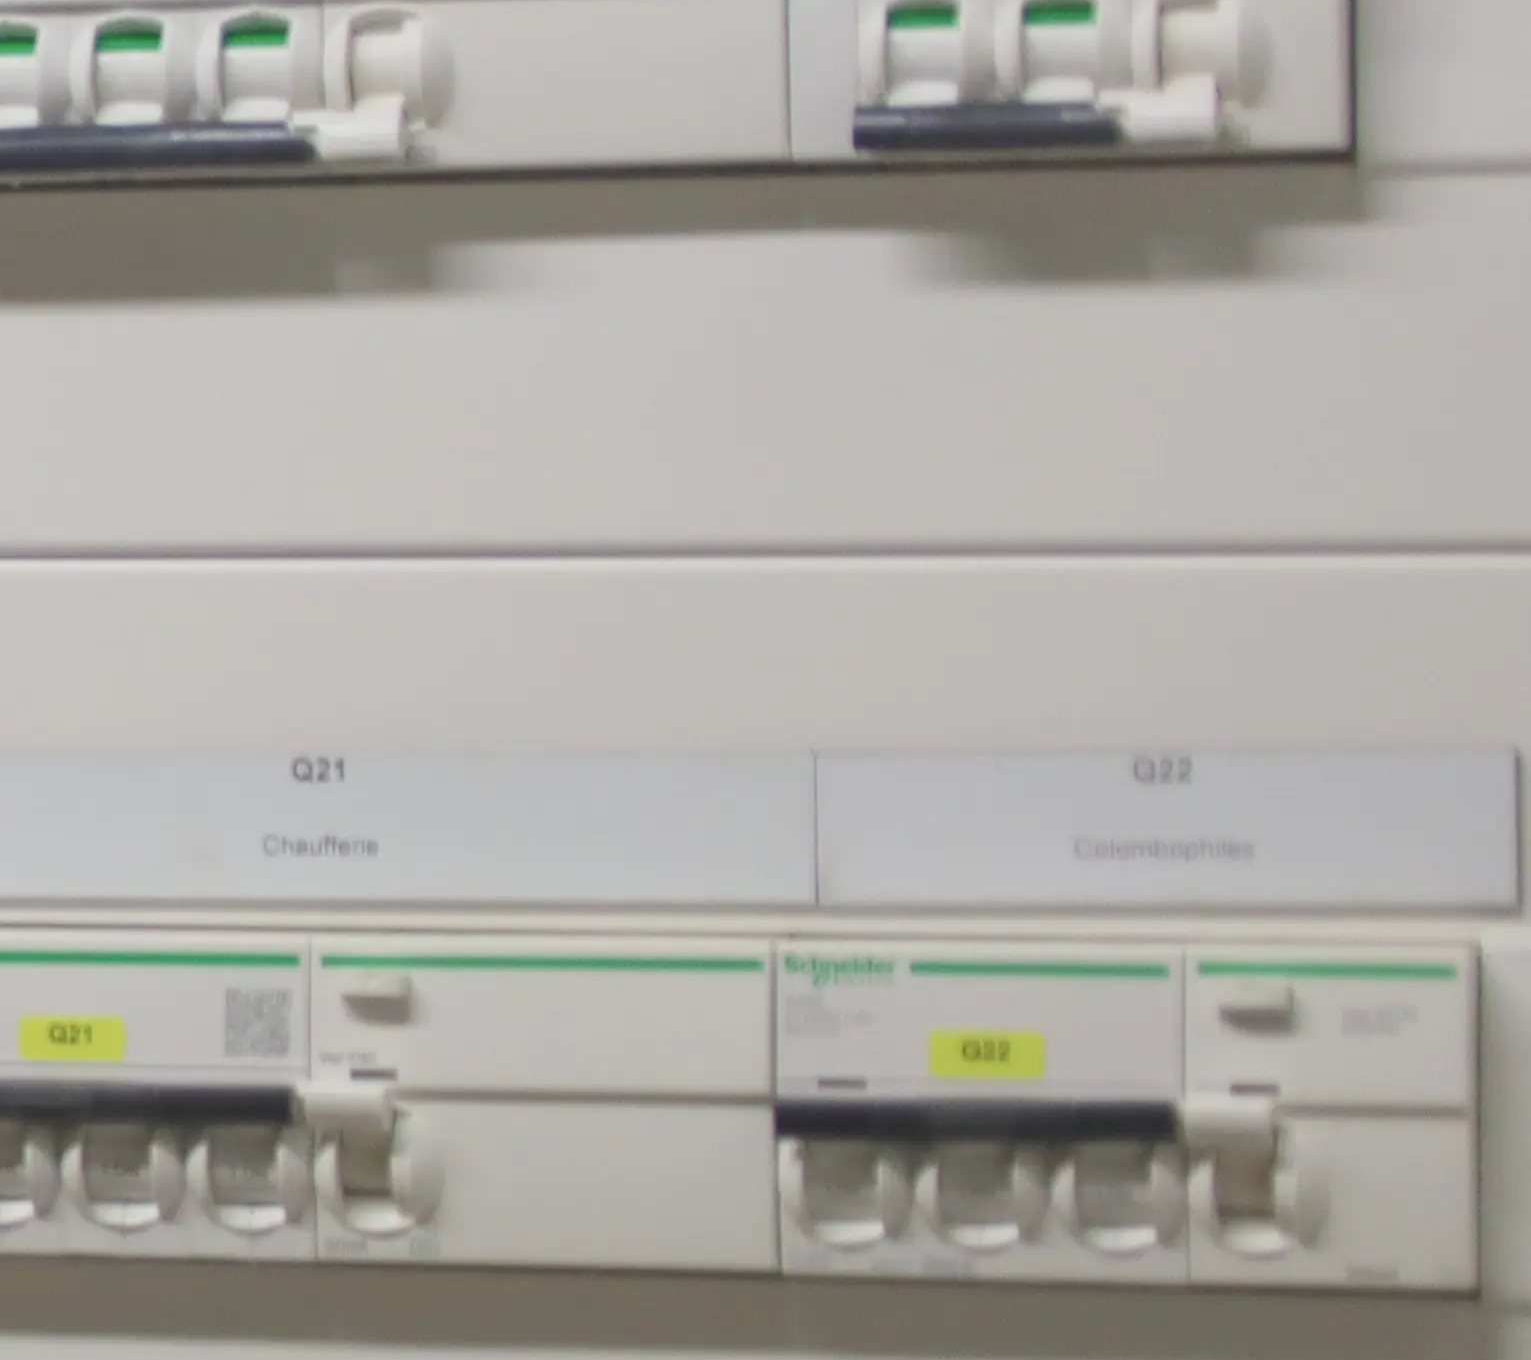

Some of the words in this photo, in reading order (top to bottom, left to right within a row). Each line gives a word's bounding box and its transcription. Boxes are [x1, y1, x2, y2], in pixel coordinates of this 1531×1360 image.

[287, 757, 352, 789] Q21
[1129, 755, 1197, 789] Q22
[263, 835, 382, 860] Chaufferie
[44, 1021, 99, 1049] Q21
[957, 1036, 1014, 1068] Q22
